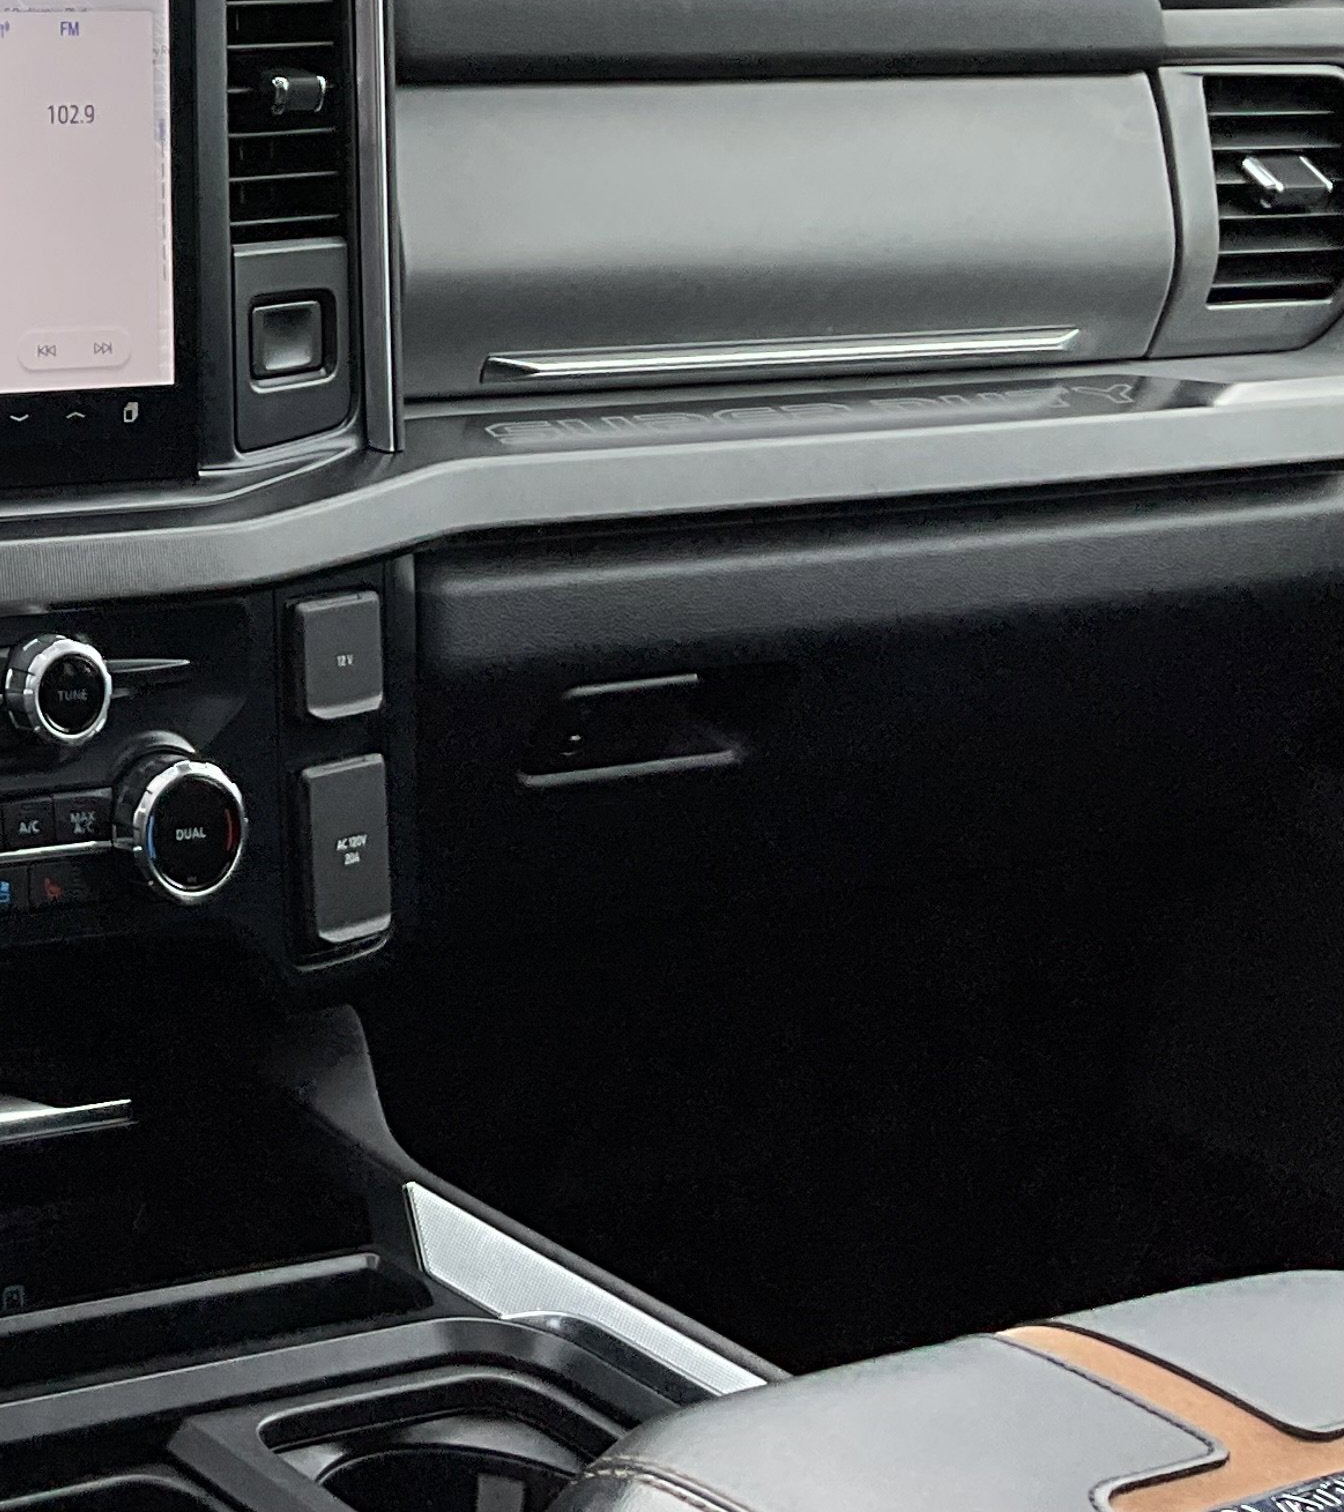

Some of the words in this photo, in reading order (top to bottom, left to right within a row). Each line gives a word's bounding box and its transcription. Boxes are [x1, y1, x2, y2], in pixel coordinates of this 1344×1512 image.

[60, 22, 80, 37] FM
[48, 104, 95, 125] 102.9
[19, 821, 40, 834] A/C
[175, 827, 207, 840] DUAL
